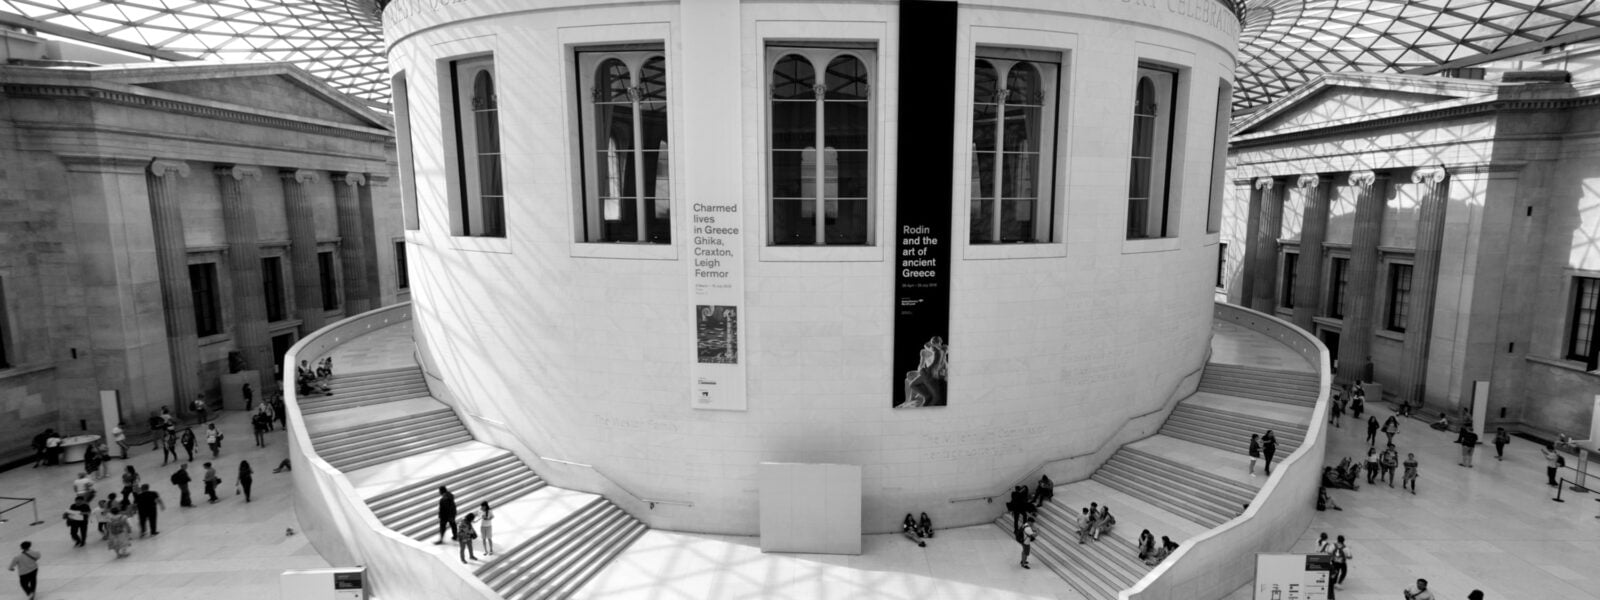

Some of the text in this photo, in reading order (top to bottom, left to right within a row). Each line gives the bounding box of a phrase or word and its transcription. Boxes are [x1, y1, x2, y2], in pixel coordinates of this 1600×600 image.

[693, 203, 737, 213] Charmed
[693, 214, 715, 223] lives
[693, 225, 739, 234] in Greece
[903, 225, 930, 234] Rodin
[694, 236, 724, 246] Ghika,
[902, 236, 938, 245] and the
[694, 247, 733, 258] Craxton,
[902, 247, 927, 256] art of
[695, 259, 720, 268] Leigh
[902, 257, 936, 267] ancient
[695, 268, 729, 278] Fermor
[902, 268, 936, 278] Greece
